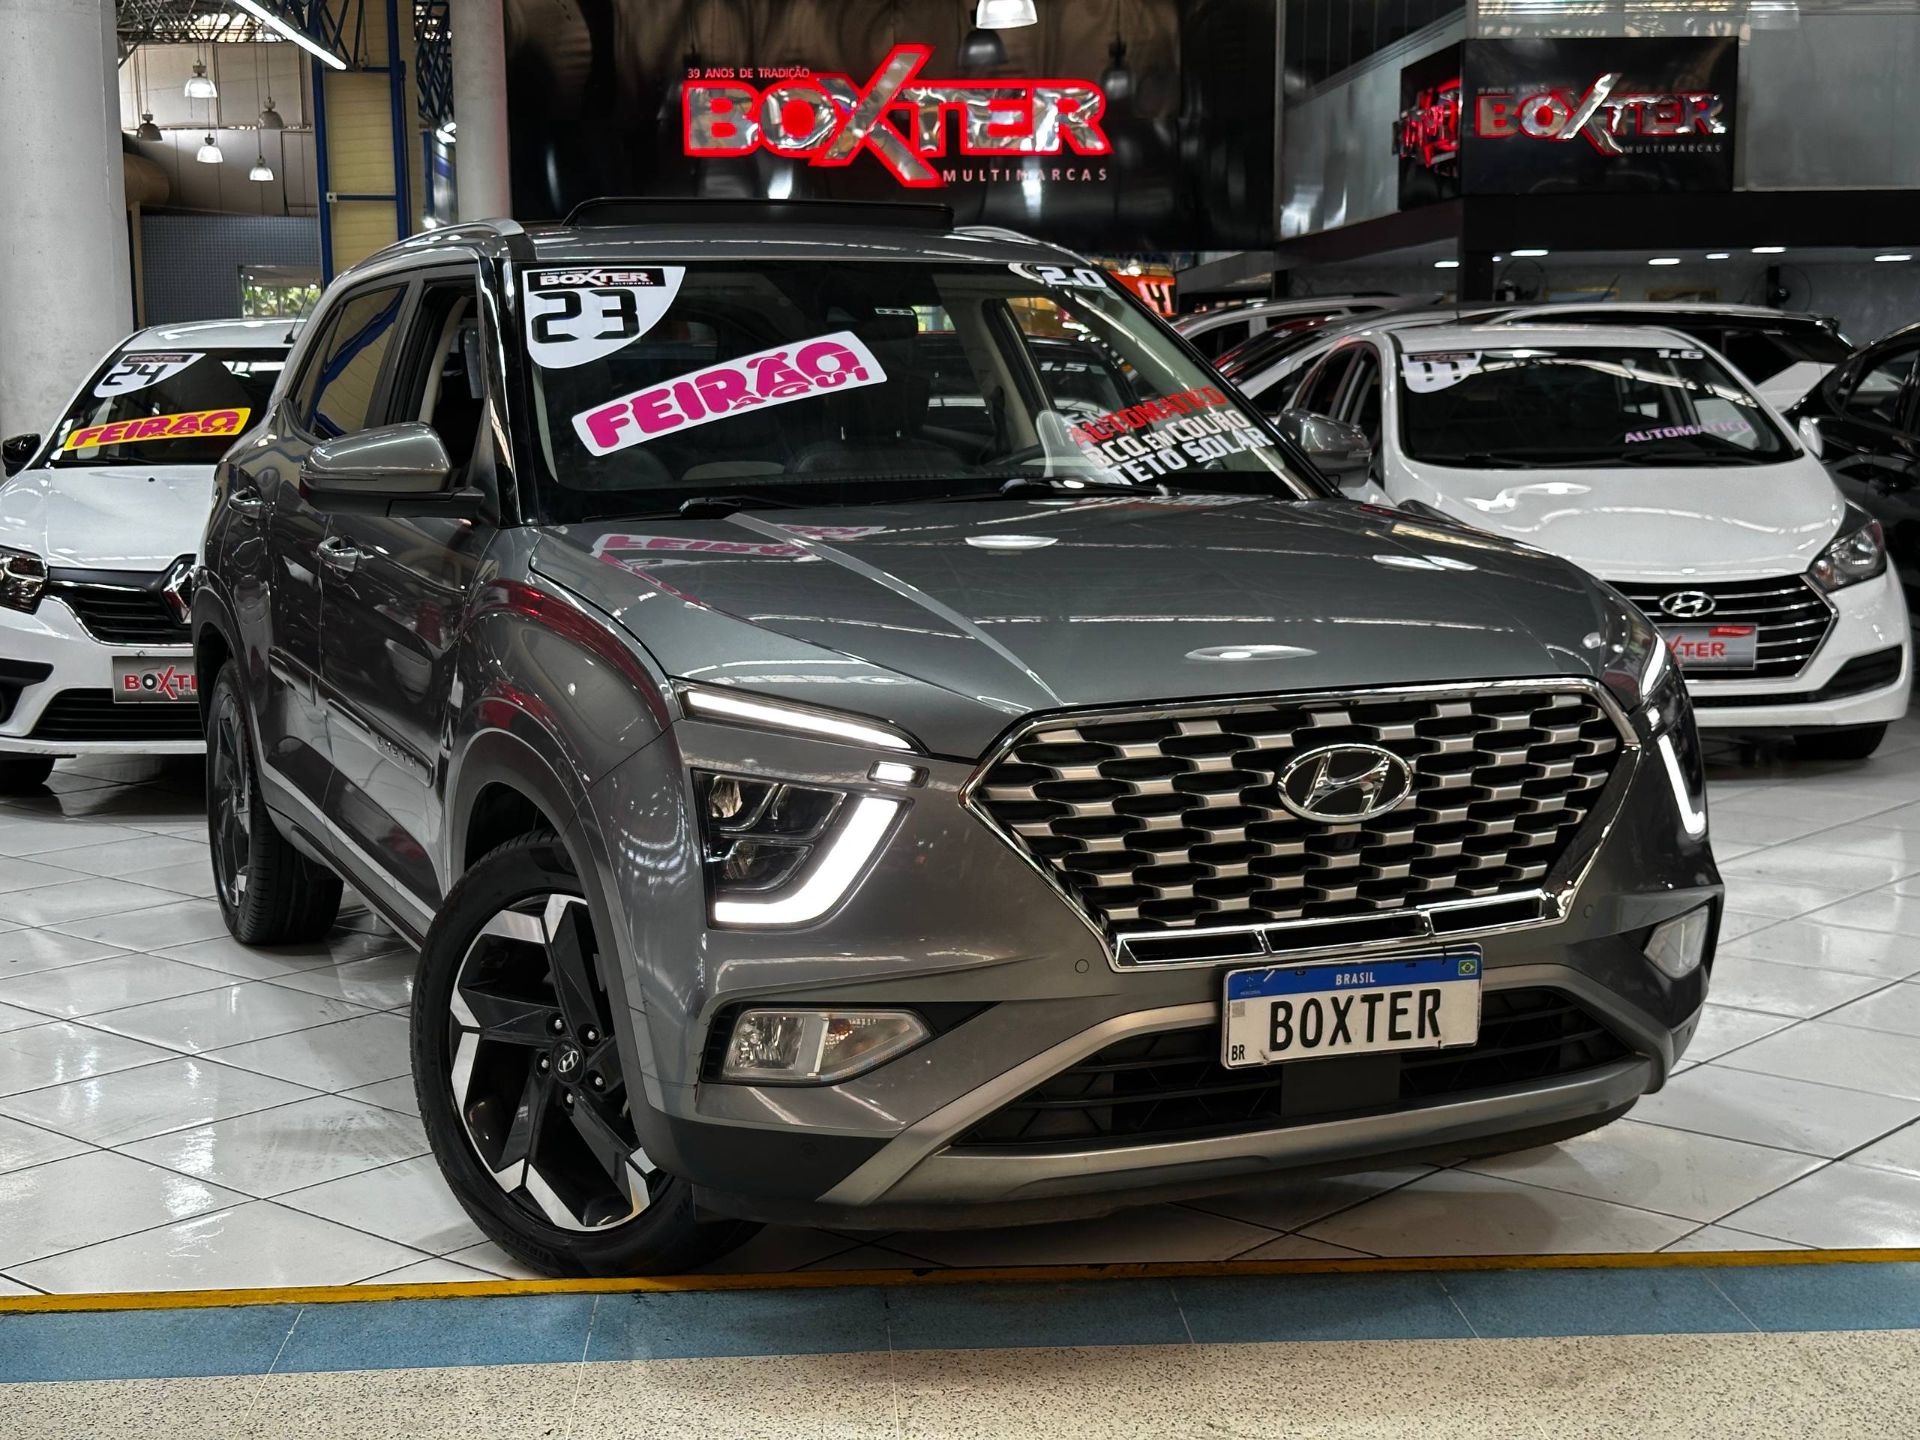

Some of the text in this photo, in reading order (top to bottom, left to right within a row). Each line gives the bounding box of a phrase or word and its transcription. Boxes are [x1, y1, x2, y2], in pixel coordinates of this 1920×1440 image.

[688, 65, 810, 80] 39 ANOS DE TRADIÇÃO
[683, 44, 1112, 186] BOXTER
[1476, 72, 1727, 156] BOXTER
[1624, 144, 1721, 154] MULTIMARCAS
[943, 168, 1107, 182] MULTIMARCAS
[540, 270, 650, 286] BOXTER
[1036, 266, 1107, 288] 2.0
[531, 289, 640, 344] 23
[102, 364, 168, 386] 24
[1041, 362, 1088, 373] 1.5
[586, 342, 860, 448] FEIRÃO
[73, 411, 239, 446] FEIRÃO
[1165, 409, 1251, 442] COURO
[1103, 427, 1274, 486] TETO SOLAR
[1336, 972, 1375, 985] BRASIL
[1270, 988, 1441, 1052] BOXTER
[1231, 1045, 1245, 1061] BR
